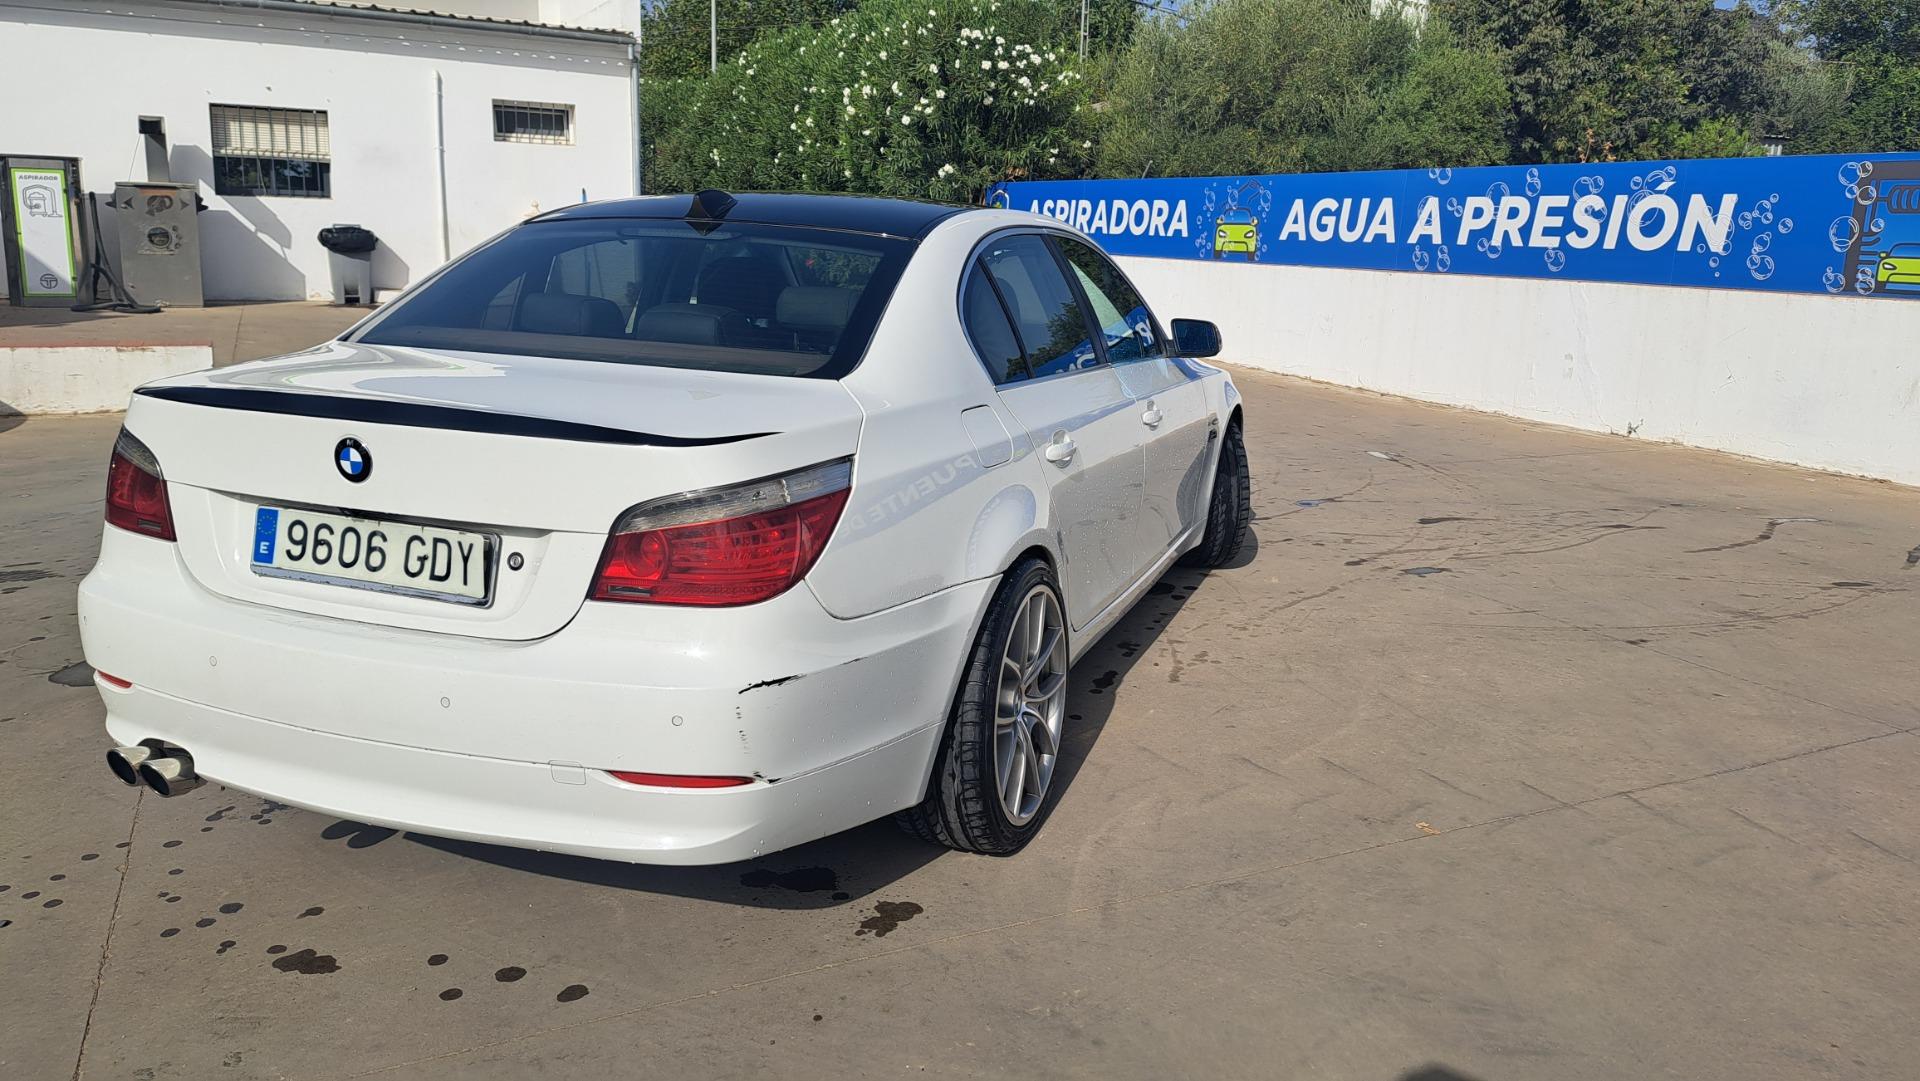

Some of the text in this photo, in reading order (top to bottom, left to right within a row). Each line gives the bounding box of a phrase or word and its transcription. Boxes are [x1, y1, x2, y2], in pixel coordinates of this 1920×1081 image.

[1279, 181, 1738, 253] AGUA A PRESIÓN
[259, 541, 269, 554] E
[285, 519, 474, 586] 9606 GDY
